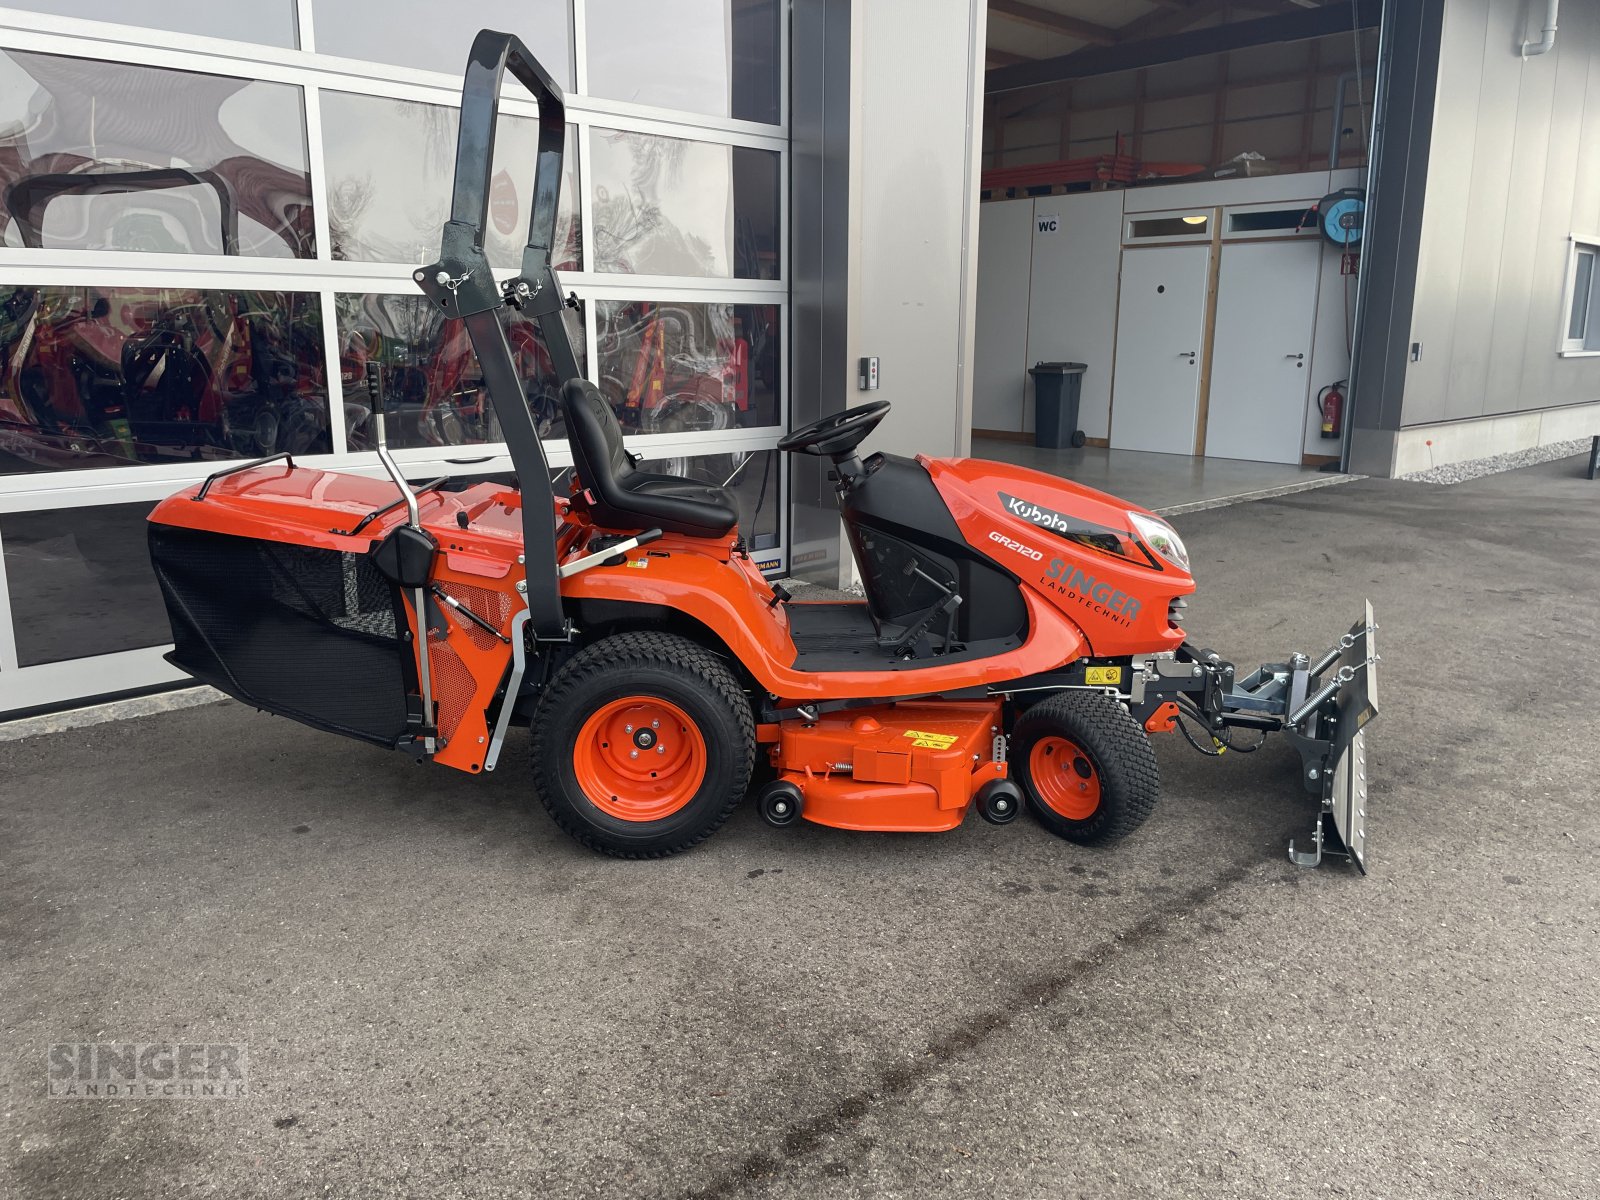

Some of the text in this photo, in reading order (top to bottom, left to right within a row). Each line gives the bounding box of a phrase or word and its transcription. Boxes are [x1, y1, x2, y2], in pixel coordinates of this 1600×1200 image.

[1038, 220, 1057, 232] WC
[1008, 497, 1068, 532] Kubota
[988, 531, 1044, 561] GR2120
[757, 560, 779, 570] RMANN
[1045, 558, 1142, 621] SINGER
